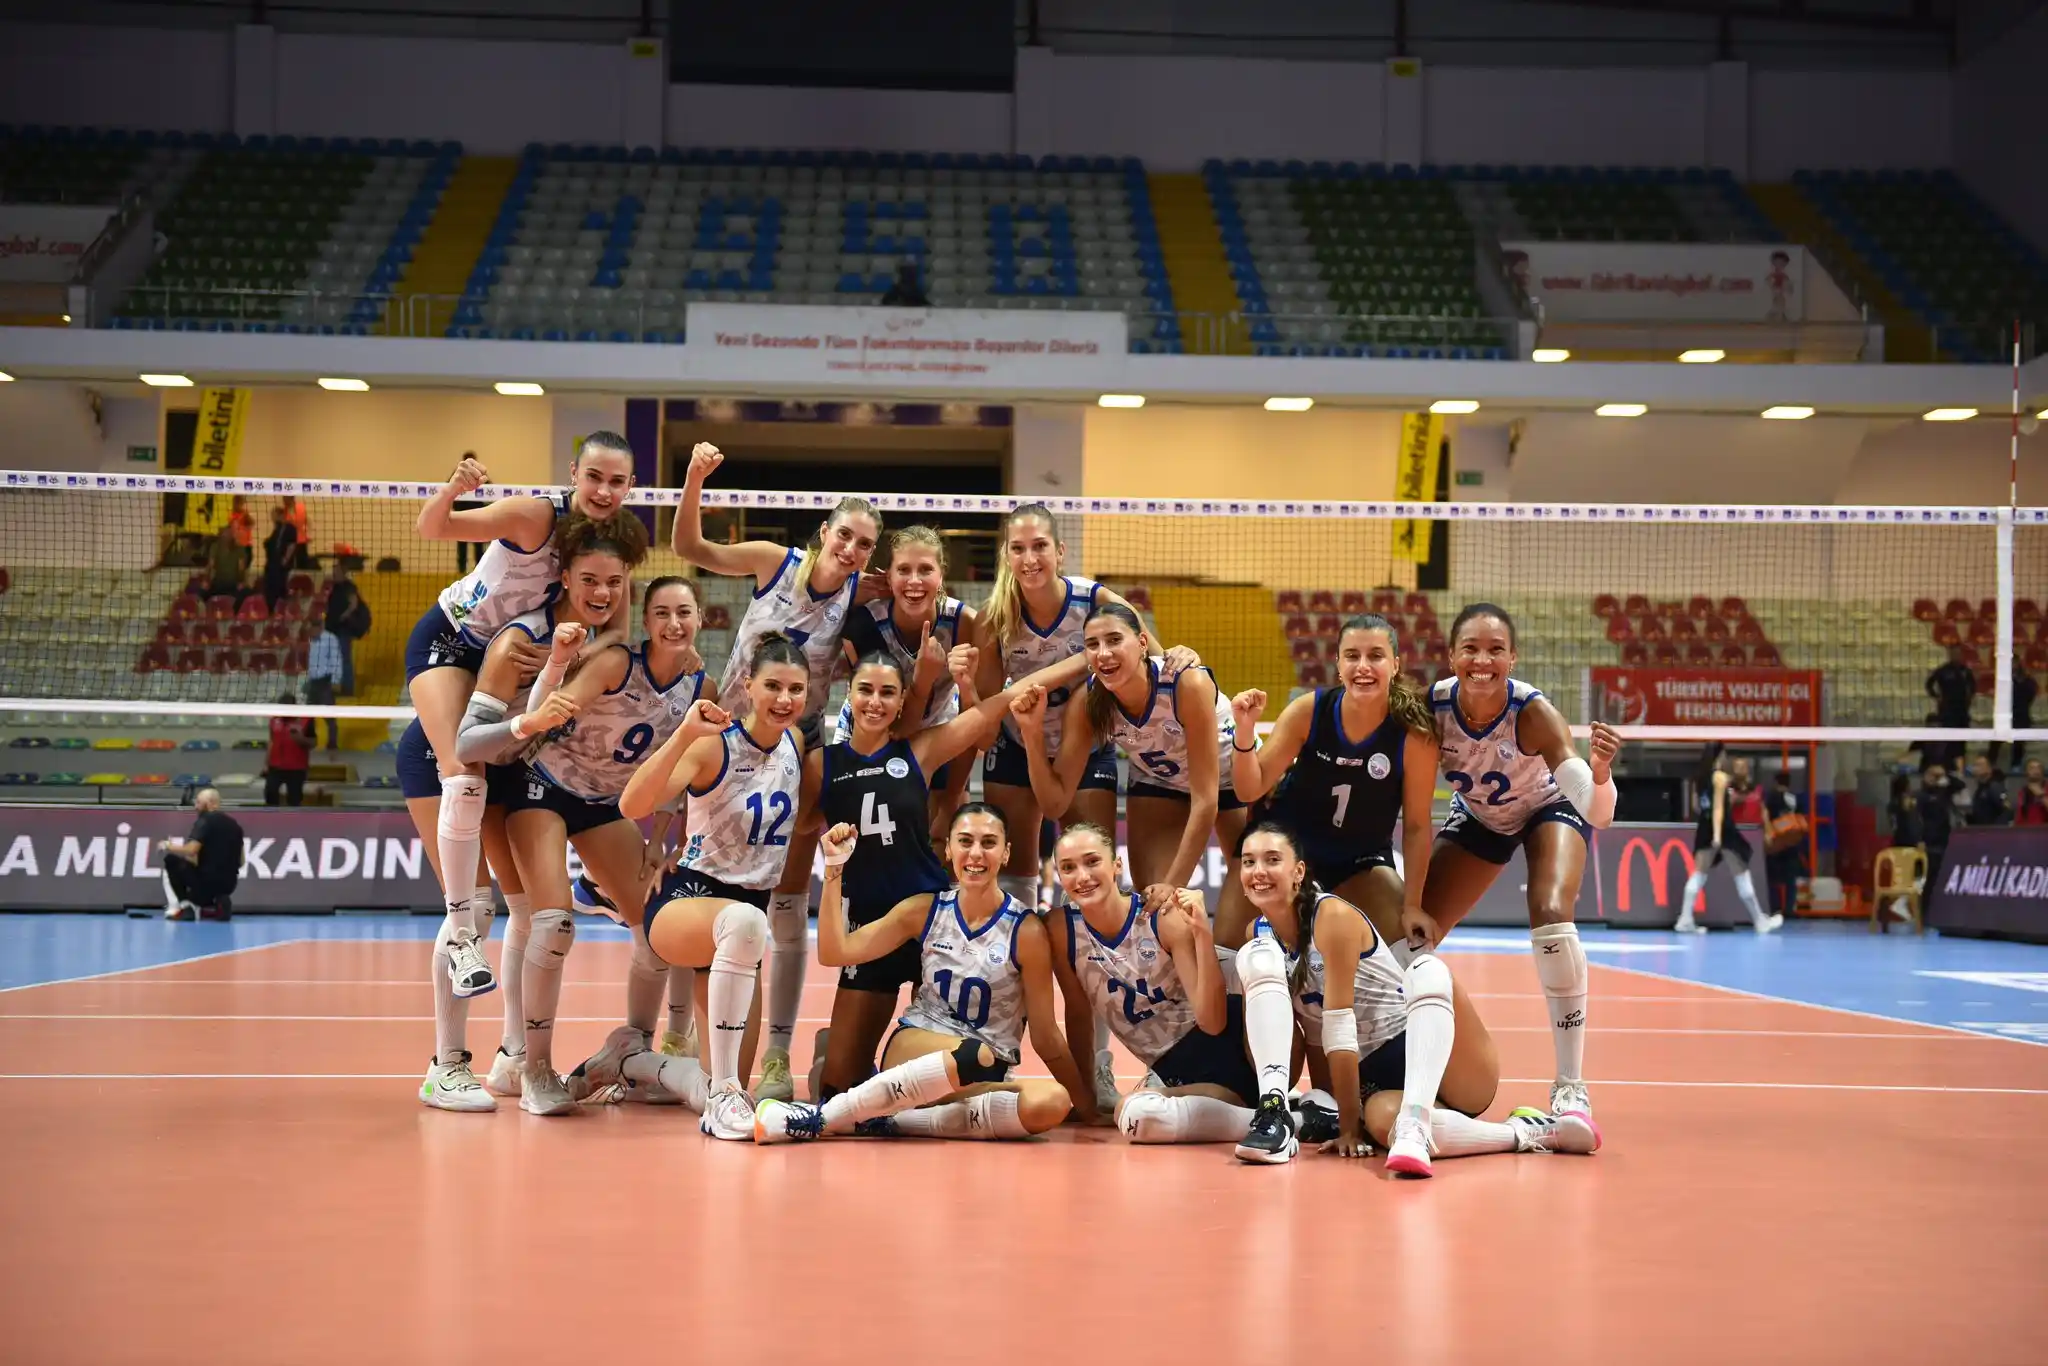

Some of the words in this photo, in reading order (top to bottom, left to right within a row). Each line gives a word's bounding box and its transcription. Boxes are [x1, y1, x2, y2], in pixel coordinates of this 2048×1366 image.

[613, 723, 654, 764] 9
[1139, 750, 1181, 778] 5
[746, 791, 792, 846] 12
[860, 791, 896, 847] 4
[1331, 784, 1352, 828] 1
[0, 835, 40, 876] A
[54, 822, 184, 878] MİL
[238, 837, 423, 880] KADIN
[1944, 864, 1961, 896] A
[1958, 855, 2011, 897] MİLLİ
[2003, 865, 2048, 900] KADI
[933, 968, 992, 1030] 10
